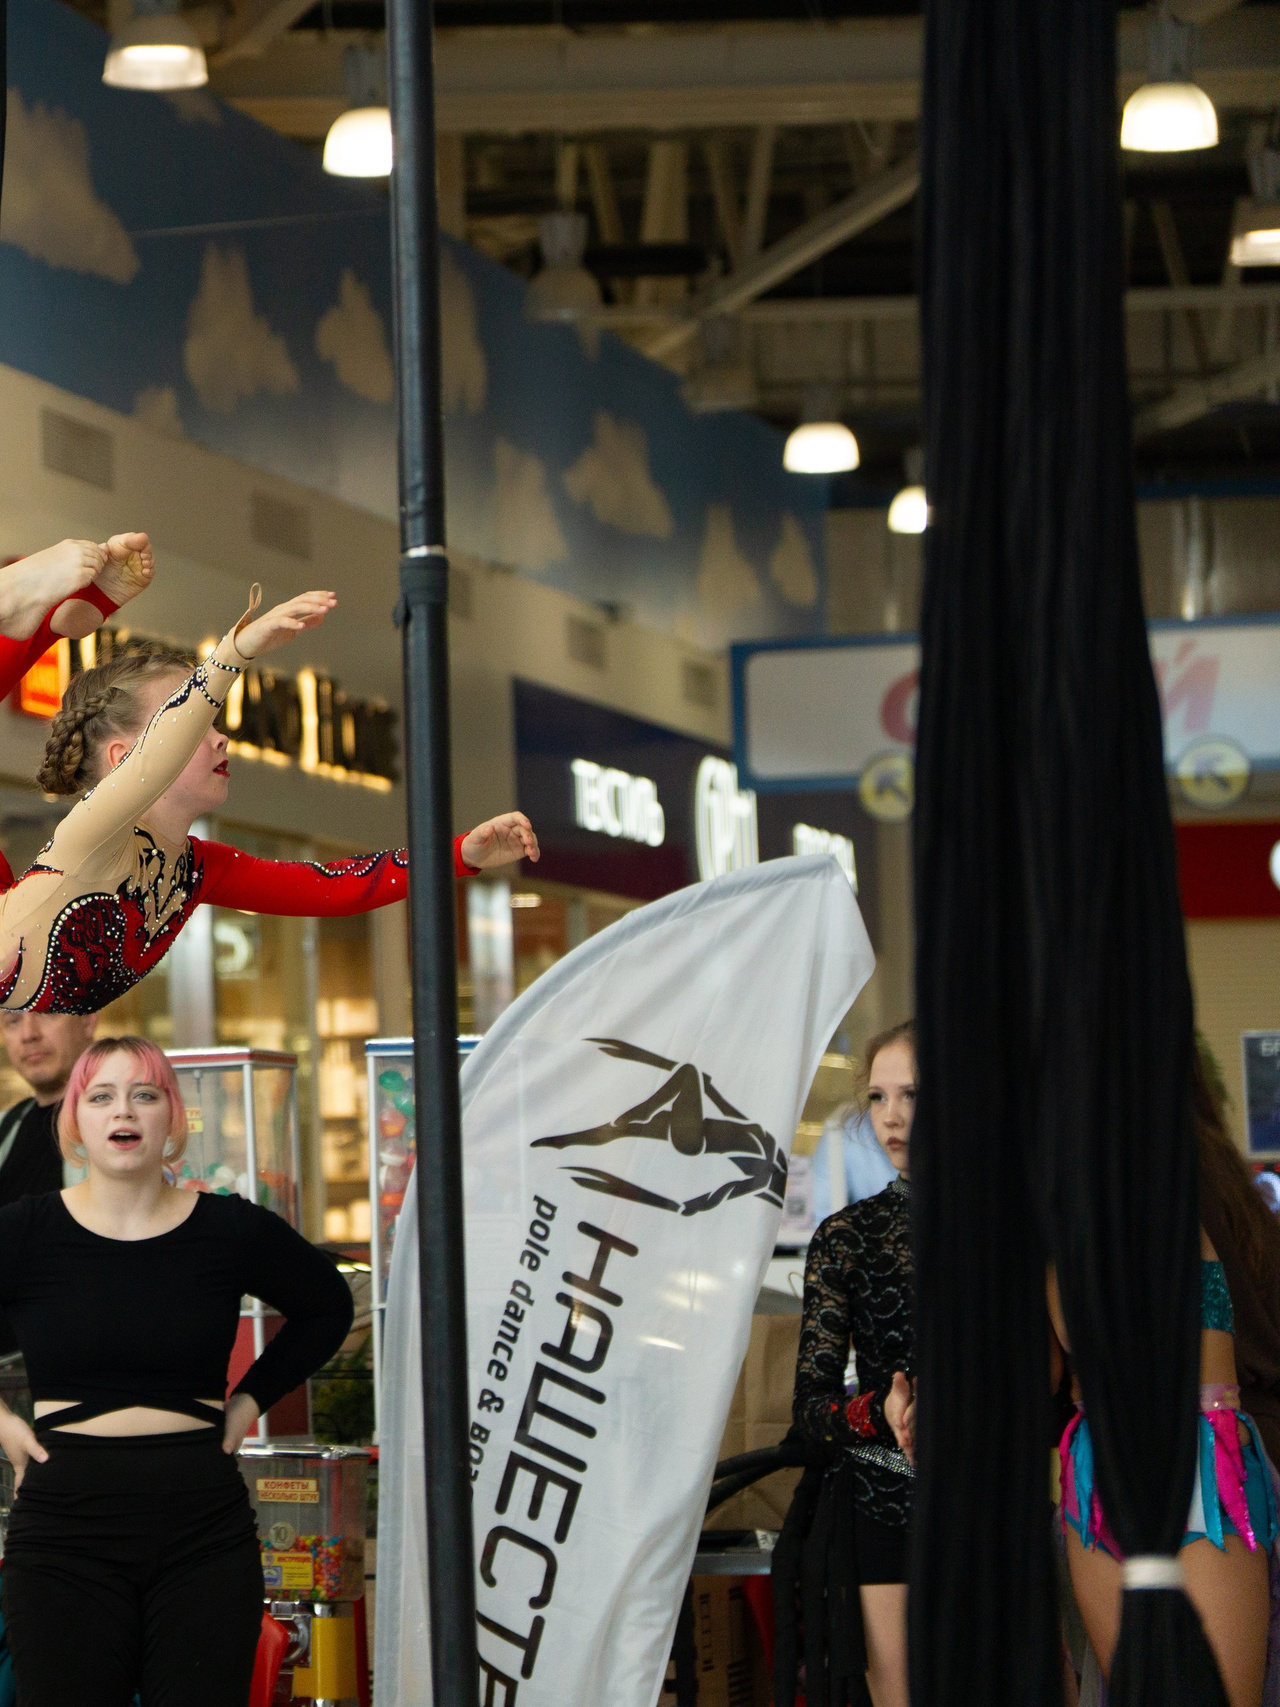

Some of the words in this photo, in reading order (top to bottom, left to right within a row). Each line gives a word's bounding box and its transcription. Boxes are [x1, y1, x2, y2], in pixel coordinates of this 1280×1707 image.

[518, 1194, 558, 1272] pole
[487, 1279, 535, 1382] dance
[477, 1388, 505, 1414] &
